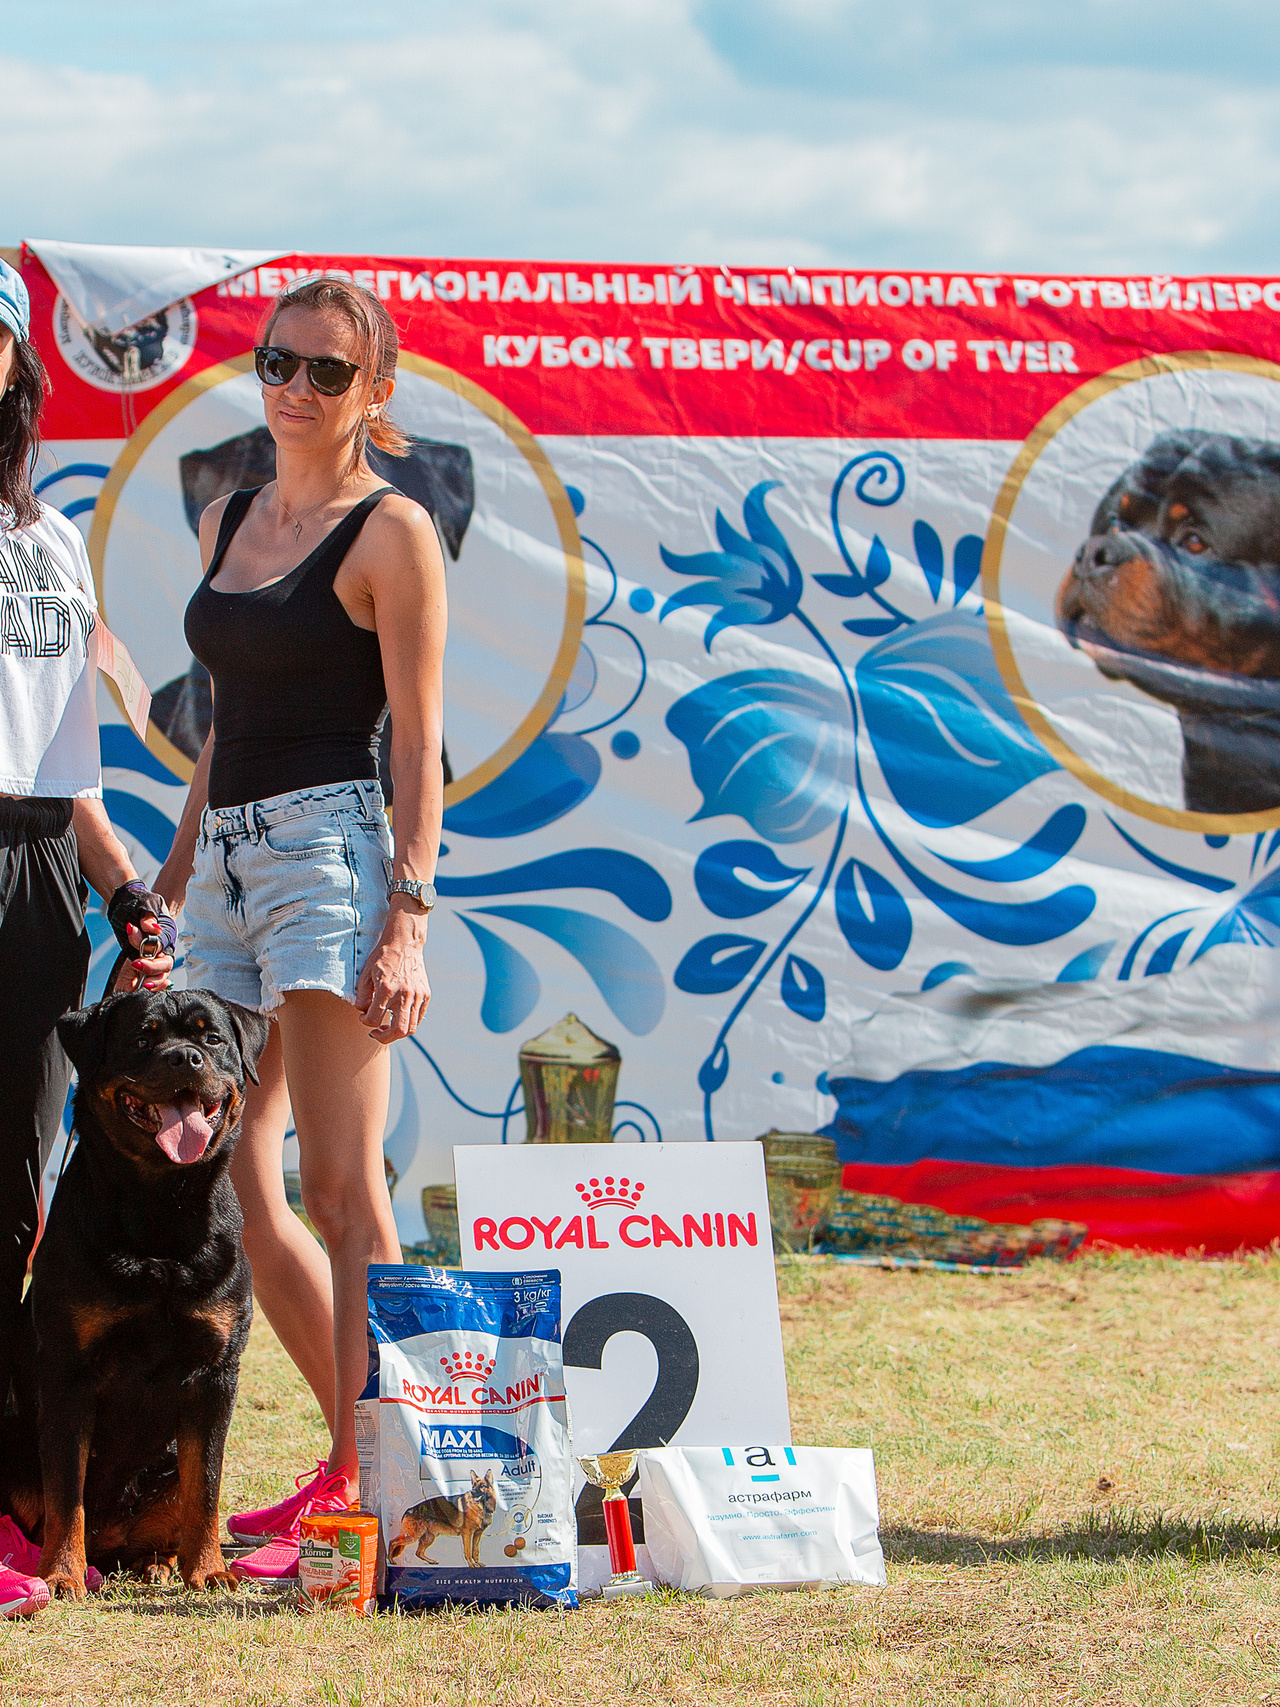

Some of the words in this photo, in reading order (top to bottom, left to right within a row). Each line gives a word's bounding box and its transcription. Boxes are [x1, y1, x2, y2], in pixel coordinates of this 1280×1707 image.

[713, 272, 1003, 307] ЧЕМПИОНАТ
[483, 335, 633, 368] КУБОК
[642, 337, 891, 375] ТВЕРИ/CUP
[900, 339, 958, 371] OF
[966, 340, 1080, 374] TVER
[472, 1214, 609, 1251] ROYAL
[618, 1212, 759, 1249] CANIN
[513, 1291, 521, 1303] 3
[402, 1378, 467, 1405] ROYAL
[471, 1373, 540, 1405] CANIN
[562, 1292, 700, 1546] 2
[422, 1430, 483, 1448] MAXI
[501, 1460, 535, 1477] Adult
[728, 1489, 812, 1504] астрафарм
